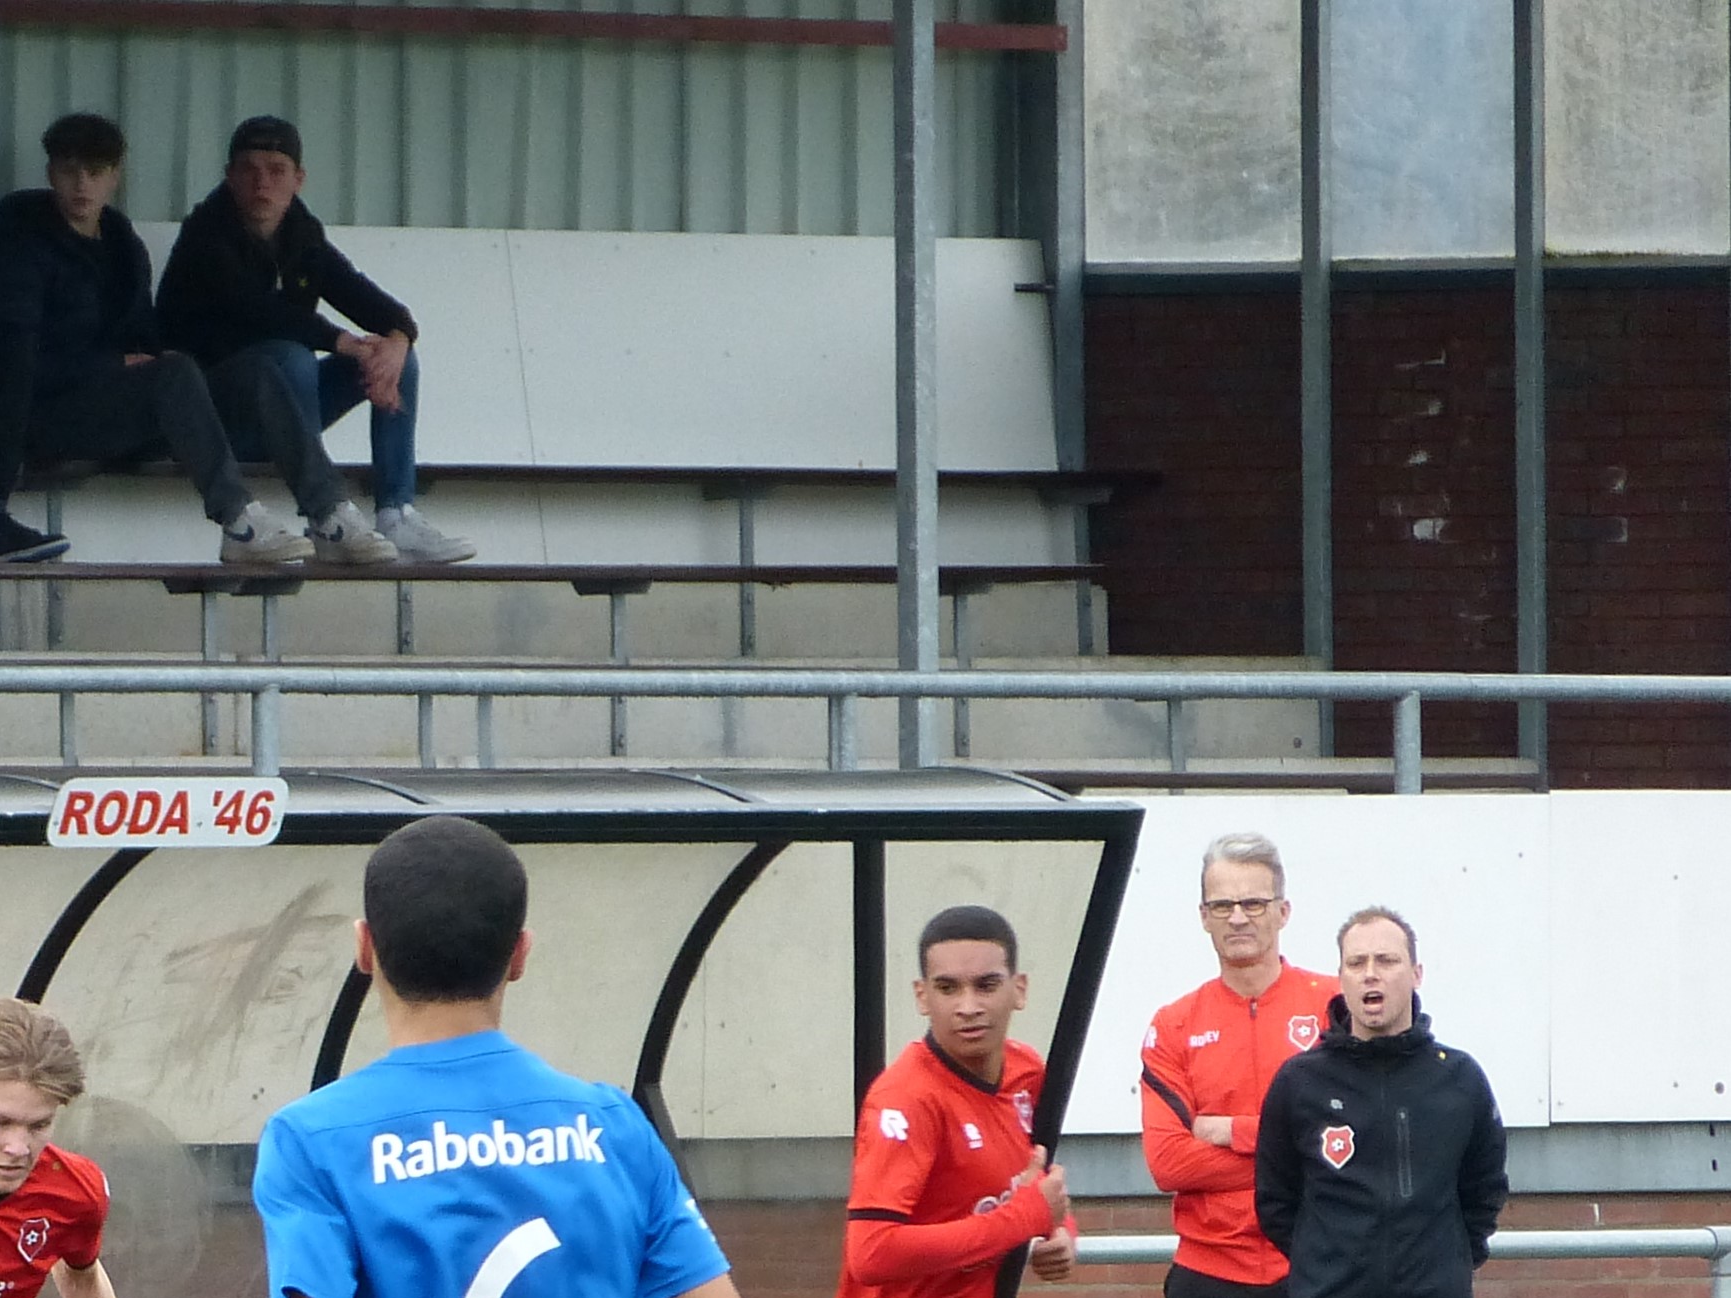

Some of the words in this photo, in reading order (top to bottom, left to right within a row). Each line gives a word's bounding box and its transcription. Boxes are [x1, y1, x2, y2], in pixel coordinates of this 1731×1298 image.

[58, 790, 189, 835] RODA
[212, 789, 275, 835] '46
[372, 1114, 606, 1184] Rabobank
